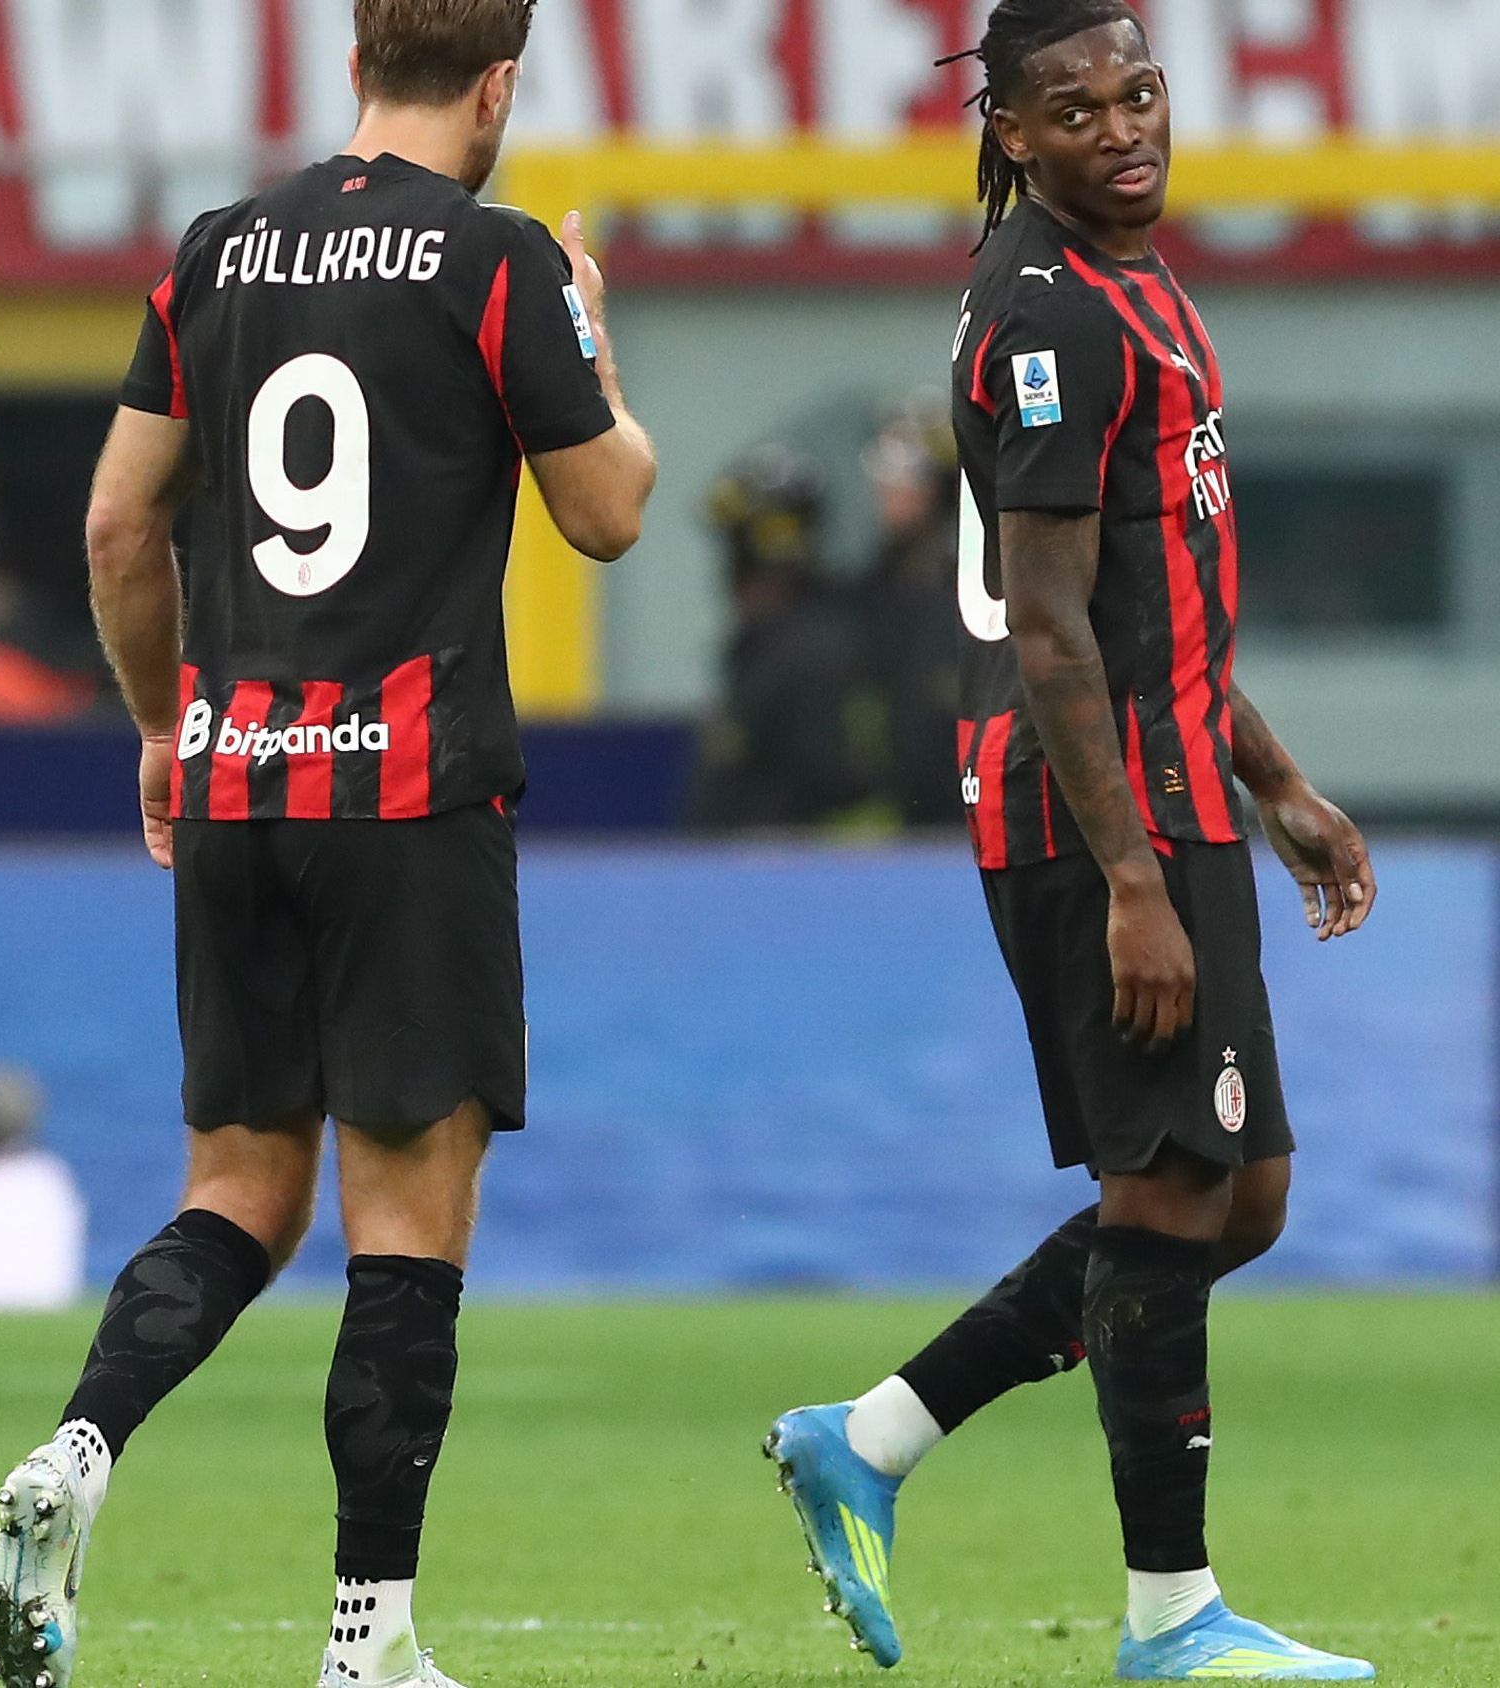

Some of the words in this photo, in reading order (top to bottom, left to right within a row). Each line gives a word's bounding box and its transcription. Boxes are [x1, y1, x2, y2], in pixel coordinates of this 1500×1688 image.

[215, 217, 446, 289] FÜLLKRUG
[247, 352, 370, 597] 9
[215, 712, 389, 766] bitpanda
